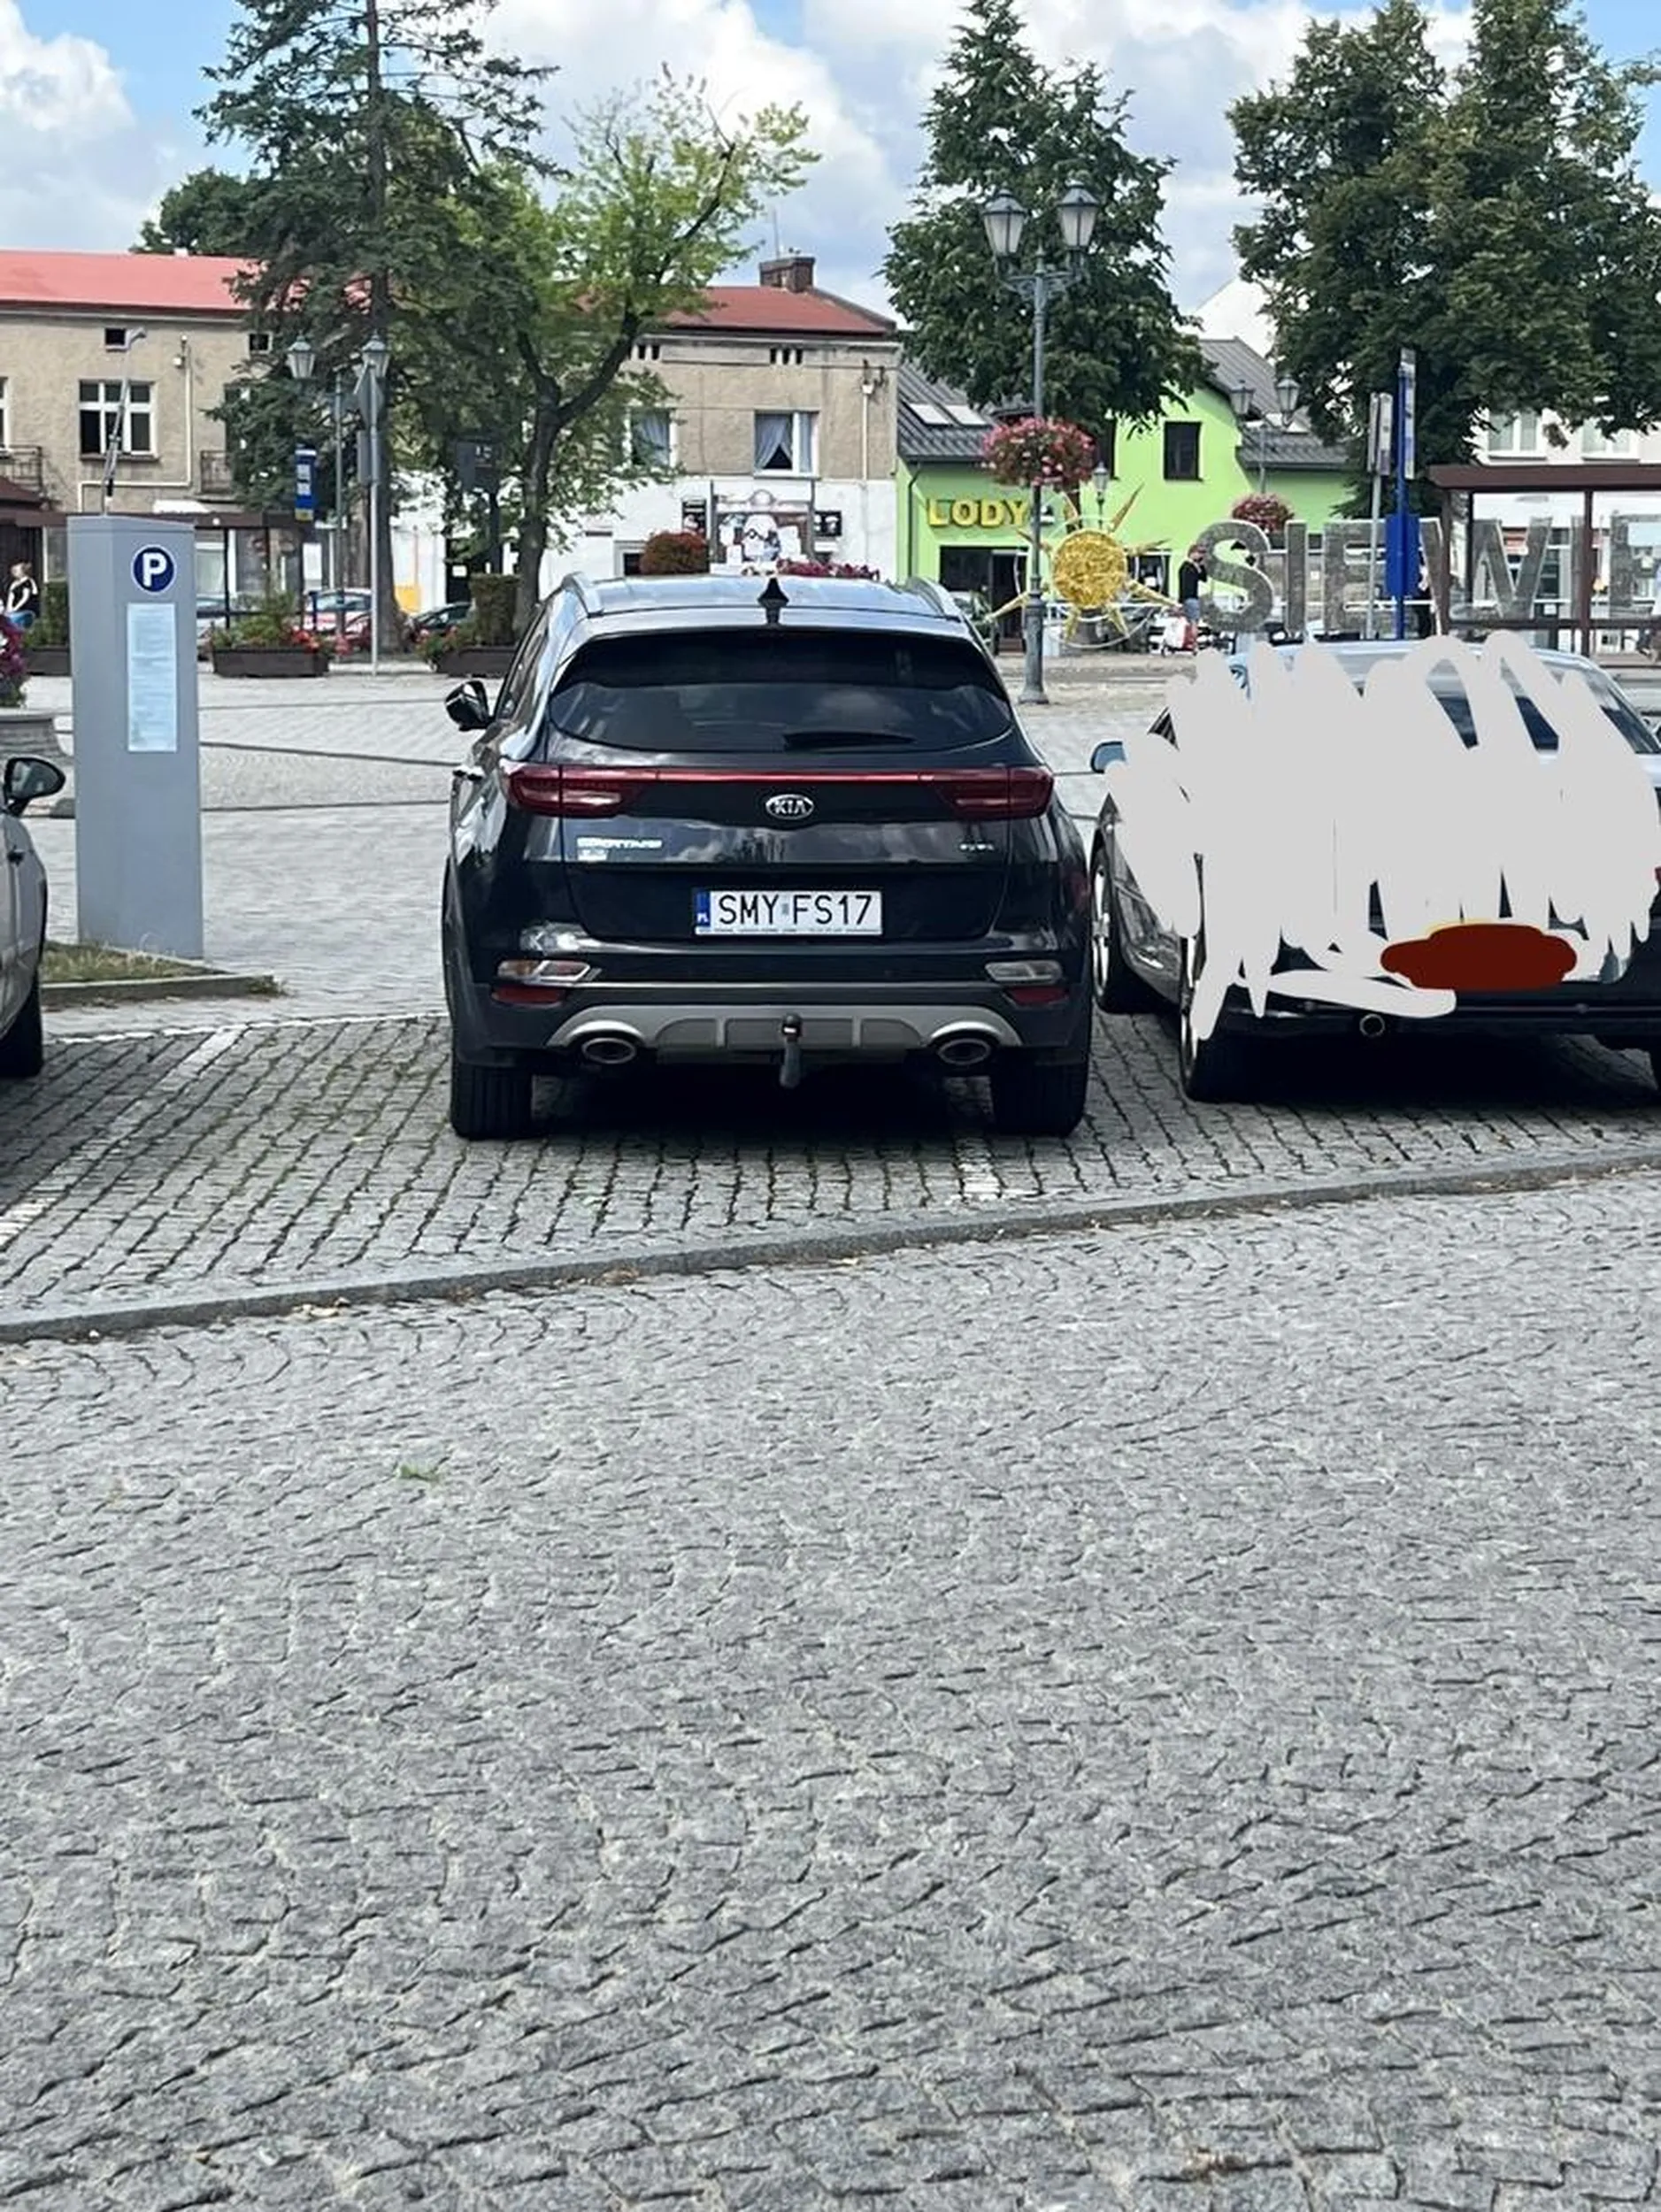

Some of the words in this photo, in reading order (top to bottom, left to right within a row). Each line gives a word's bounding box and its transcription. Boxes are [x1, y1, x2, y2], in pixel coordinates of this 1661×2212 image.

[927, 498, 1029, 528] LODY
[142, 551, 167, 588] P
[773, 798, 806, 815] KIA
[718, 894, 780, 926] SMY
[793, 894, 873, 926] FS17
